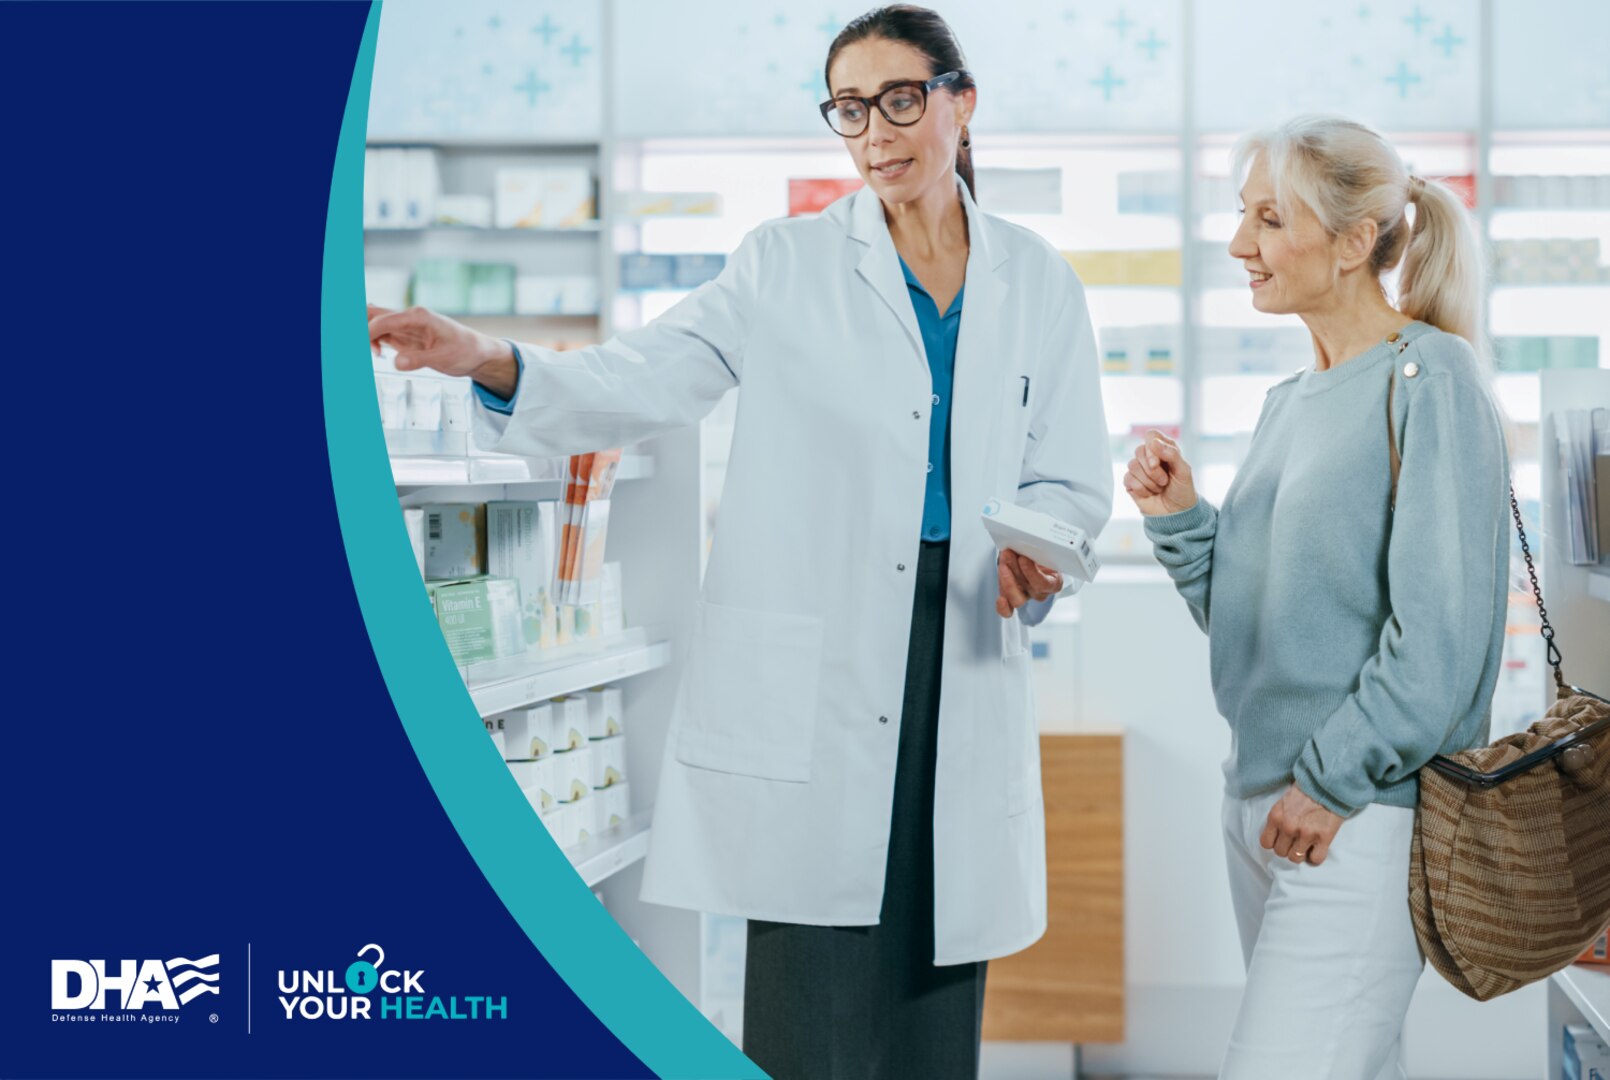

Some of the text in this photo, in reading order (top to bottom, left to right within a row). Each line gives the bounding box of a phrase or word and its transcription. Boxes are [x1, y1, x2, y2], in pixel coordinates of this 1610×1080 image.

[442, 596, 481, 611] Vitamin E
[497, 719, 505, 730] E
